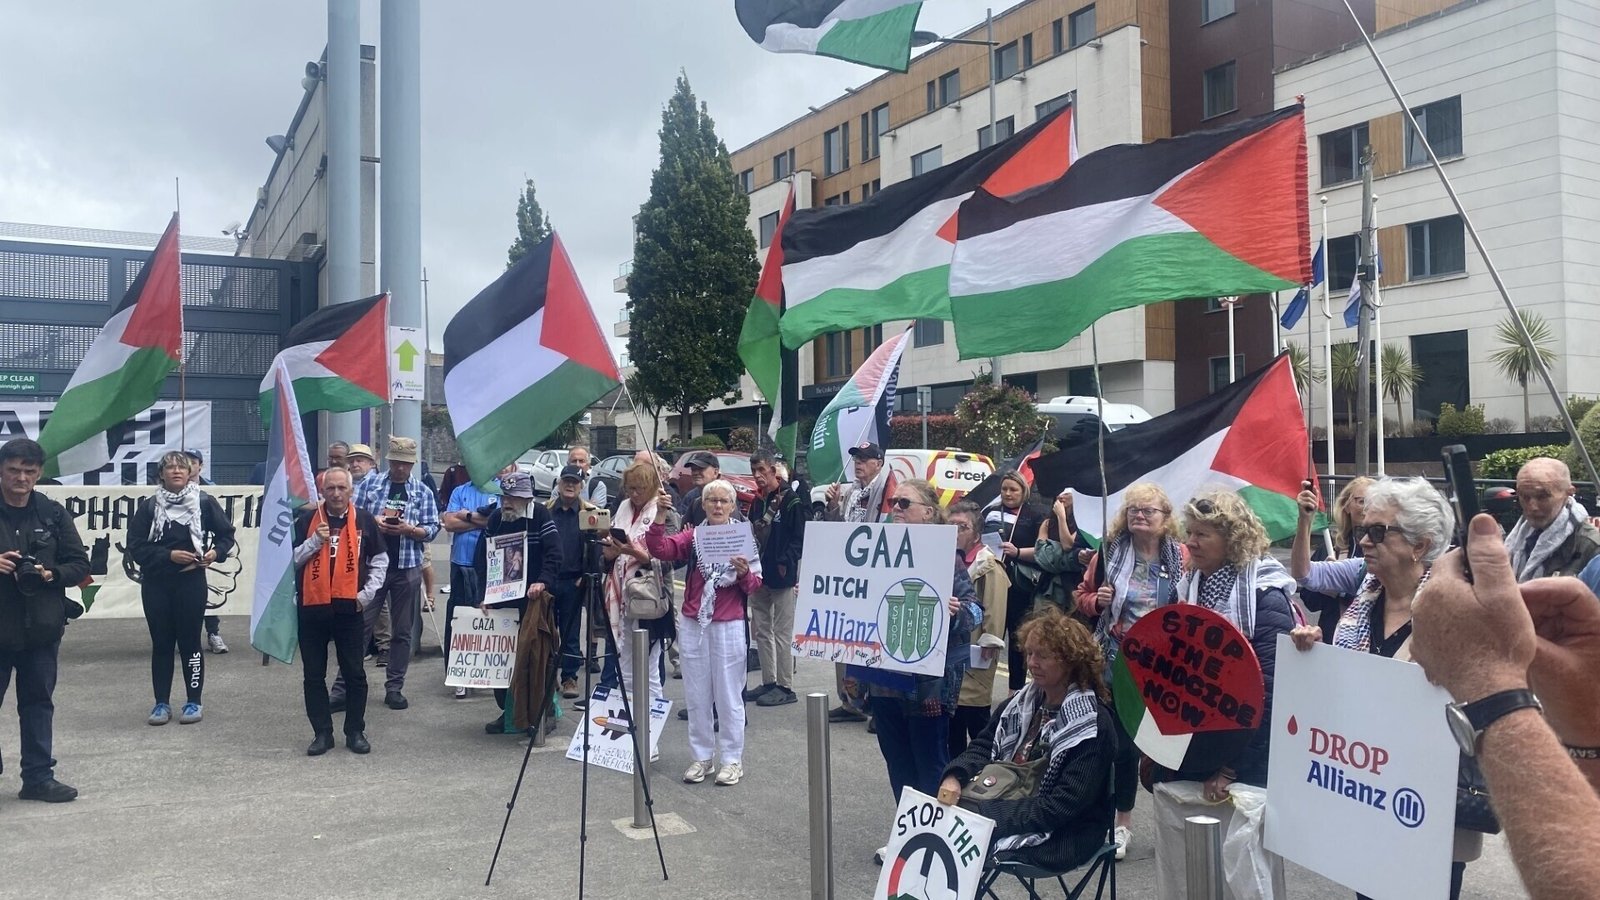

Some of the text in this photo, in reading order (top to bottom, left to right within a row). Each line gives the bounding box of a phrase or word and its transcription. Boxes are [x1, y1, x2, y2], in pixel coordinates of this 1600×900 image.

[945, 468, 987, 482] circet
[845, 525, 914, 568] GAA
[813, 574, 869, 599] DITCH
[472, 617, 495, 631] GAZA
[805, 609, 878, 645] Allianz
[891, 605, 899, 643] STOP
[920, 607, 930, 645] DROP
[1162, 610, 1244, 659] STOP
[448, 666, 466, 677] IRISH
[455, 653, 510, 667] ACT NOW
[1169, 635, 1224, 680] THE
[1123, 637, 1256, 727] GENOCIDE
[1144, 679, 1205, 727] NOW
[1308, 727, 1389, 775] DROP
[1568, 748, 1598, 759] SAV
[1307, 760, 1387, 811] Allianz
[897, 802, 981, 868] STOP THE
